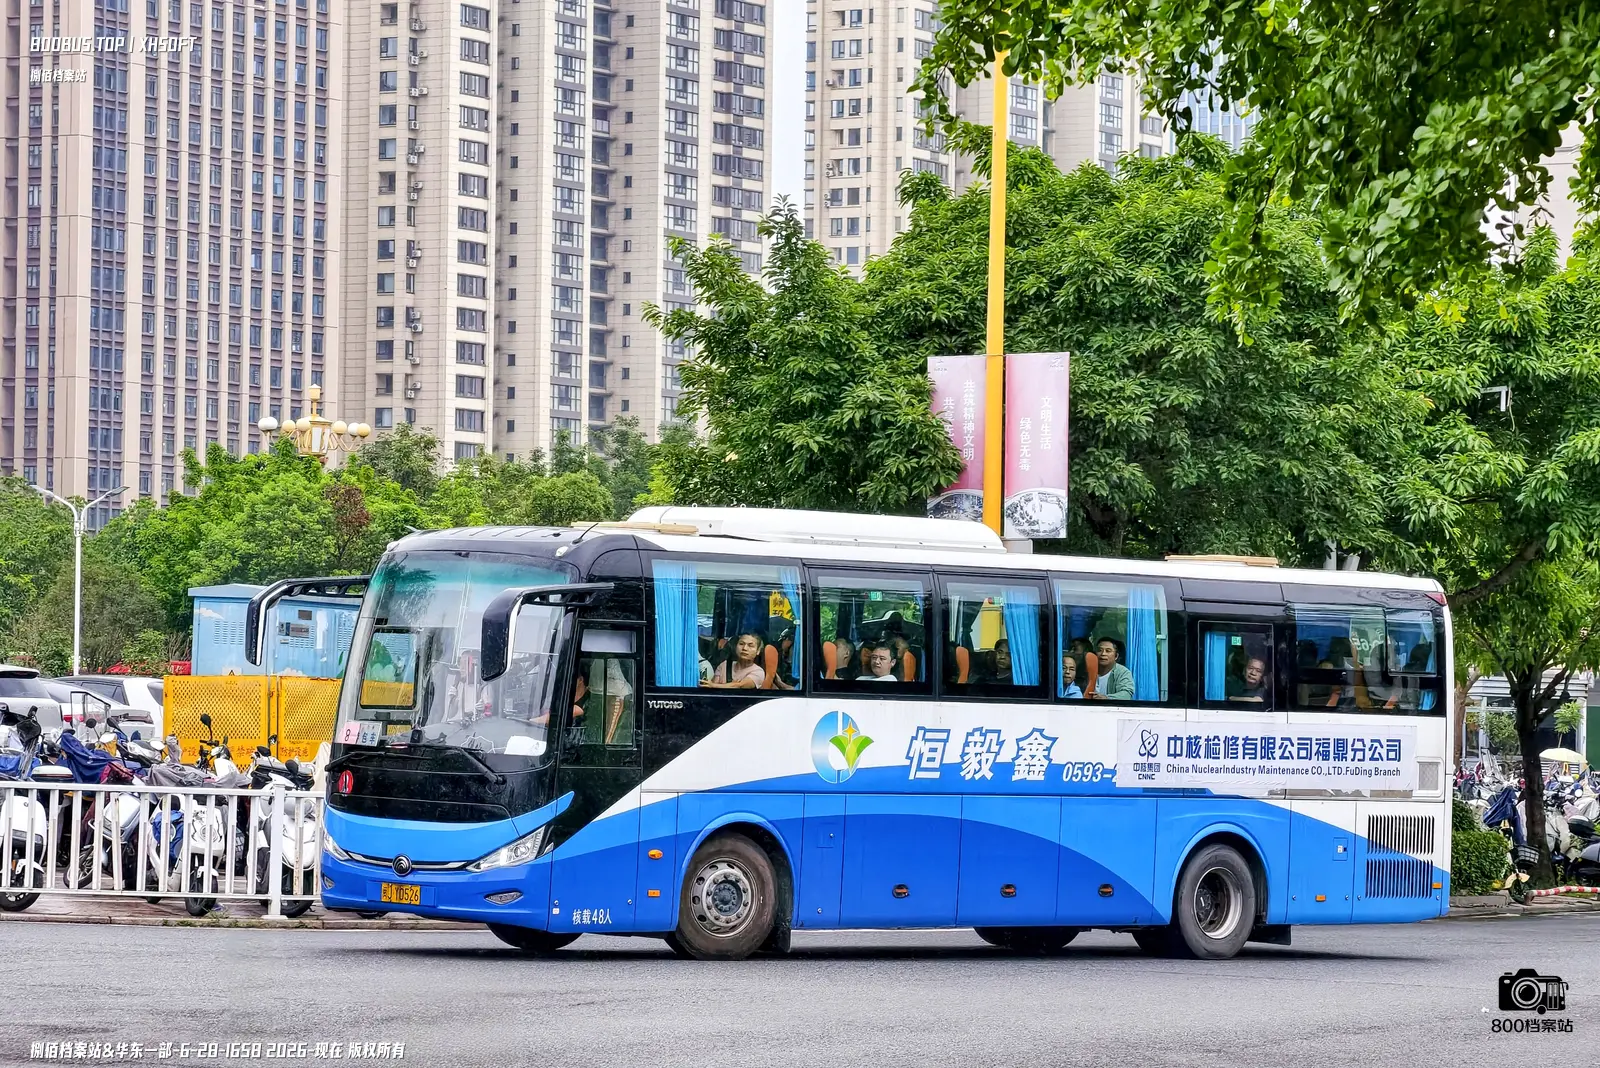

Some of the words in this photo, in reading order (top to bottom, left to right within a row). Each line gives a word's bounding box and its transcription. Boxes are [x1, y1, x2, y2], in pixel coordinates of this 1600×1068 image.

[1039, 396, 1052, 449] 文明生活
[1019, 417, 1032, 472] 绿色无毒
[647, 700, 684, 709] YUTONG
[906, 727, 1058, 782] 恒毅鑫
[1166, 735, 1402, 762] 中核检修有限公司福鼎分公司
[1133, 762, 1161, 772] 中核集团
[1166, 764, 1190, 774] China
[1258, 765, 1309, 775] Maintenance
[1374, 766, 1401, 776] Branch
[572, 908, 612, 925] 核载48人
